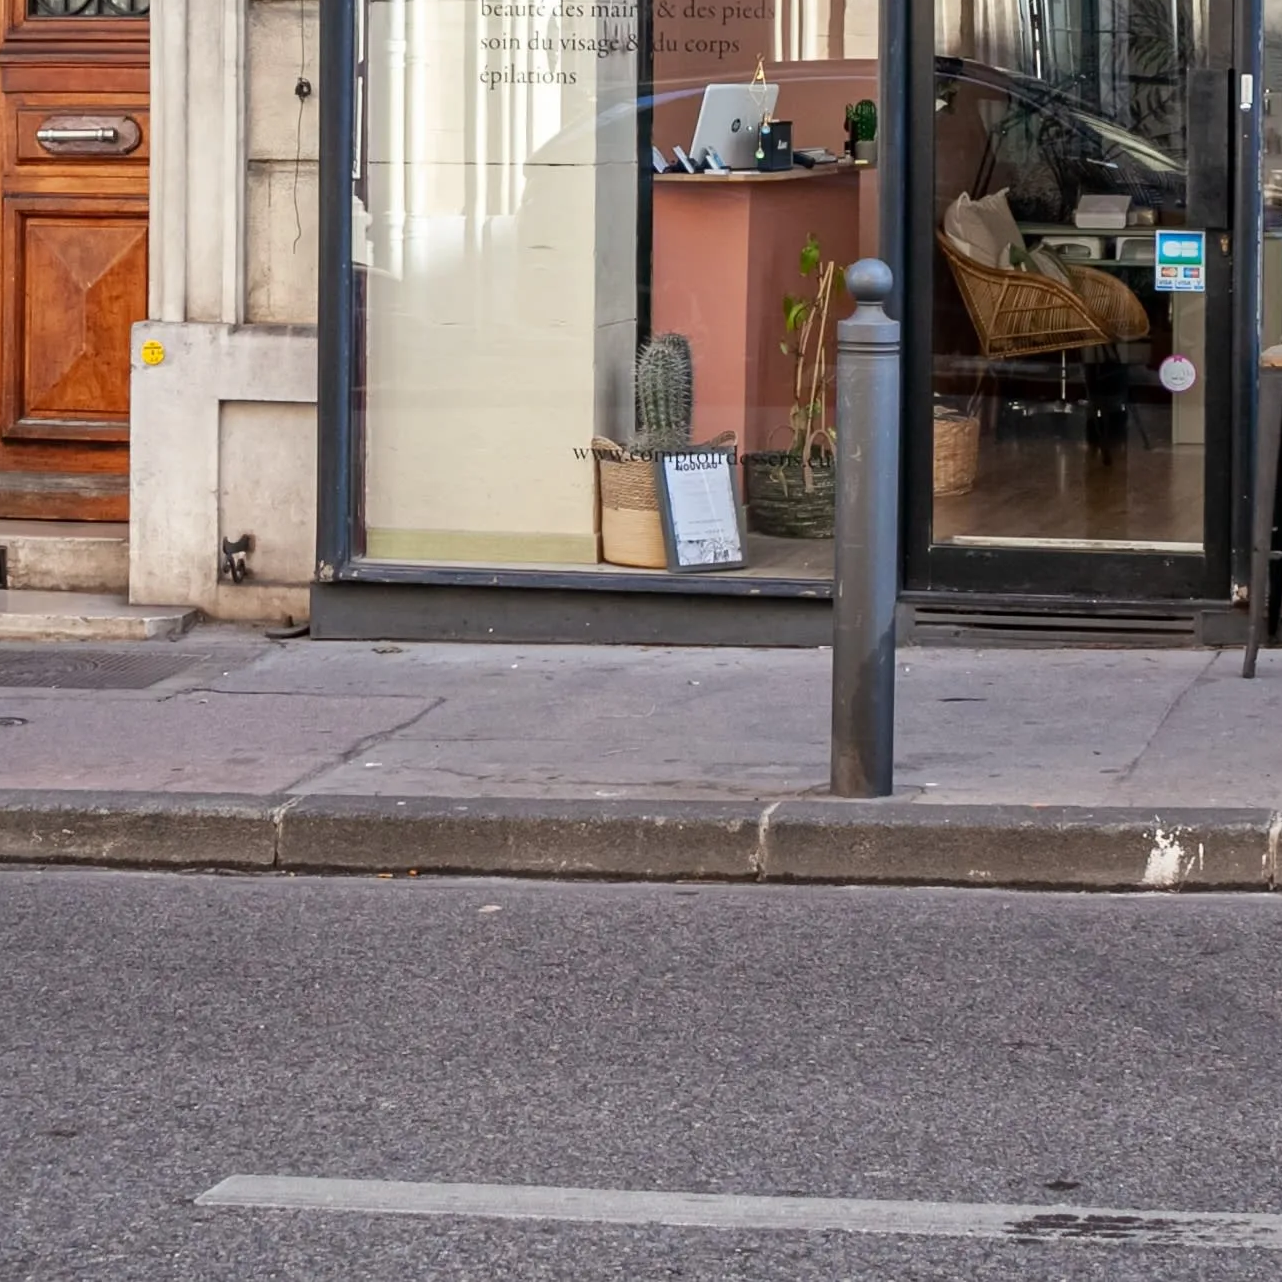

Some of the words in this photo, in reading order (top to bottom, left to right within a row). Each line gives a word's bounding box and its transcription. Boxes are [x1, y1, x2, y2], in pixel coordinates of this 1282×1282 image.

[590, 0, 649, 18] main
[657, 0, 676, 18] &
[480, 33, 520, 51] soin
[528, 31, 553, 50] du
[559, 33, 620, 58] visage
[625, 33, 640, 51] &
[653, 31, 677, 51] du
[685, 39, 740, 59] corps
[479, 64, 577, 90] épilations
[676, 462, 718, 472] NOUVEAU
